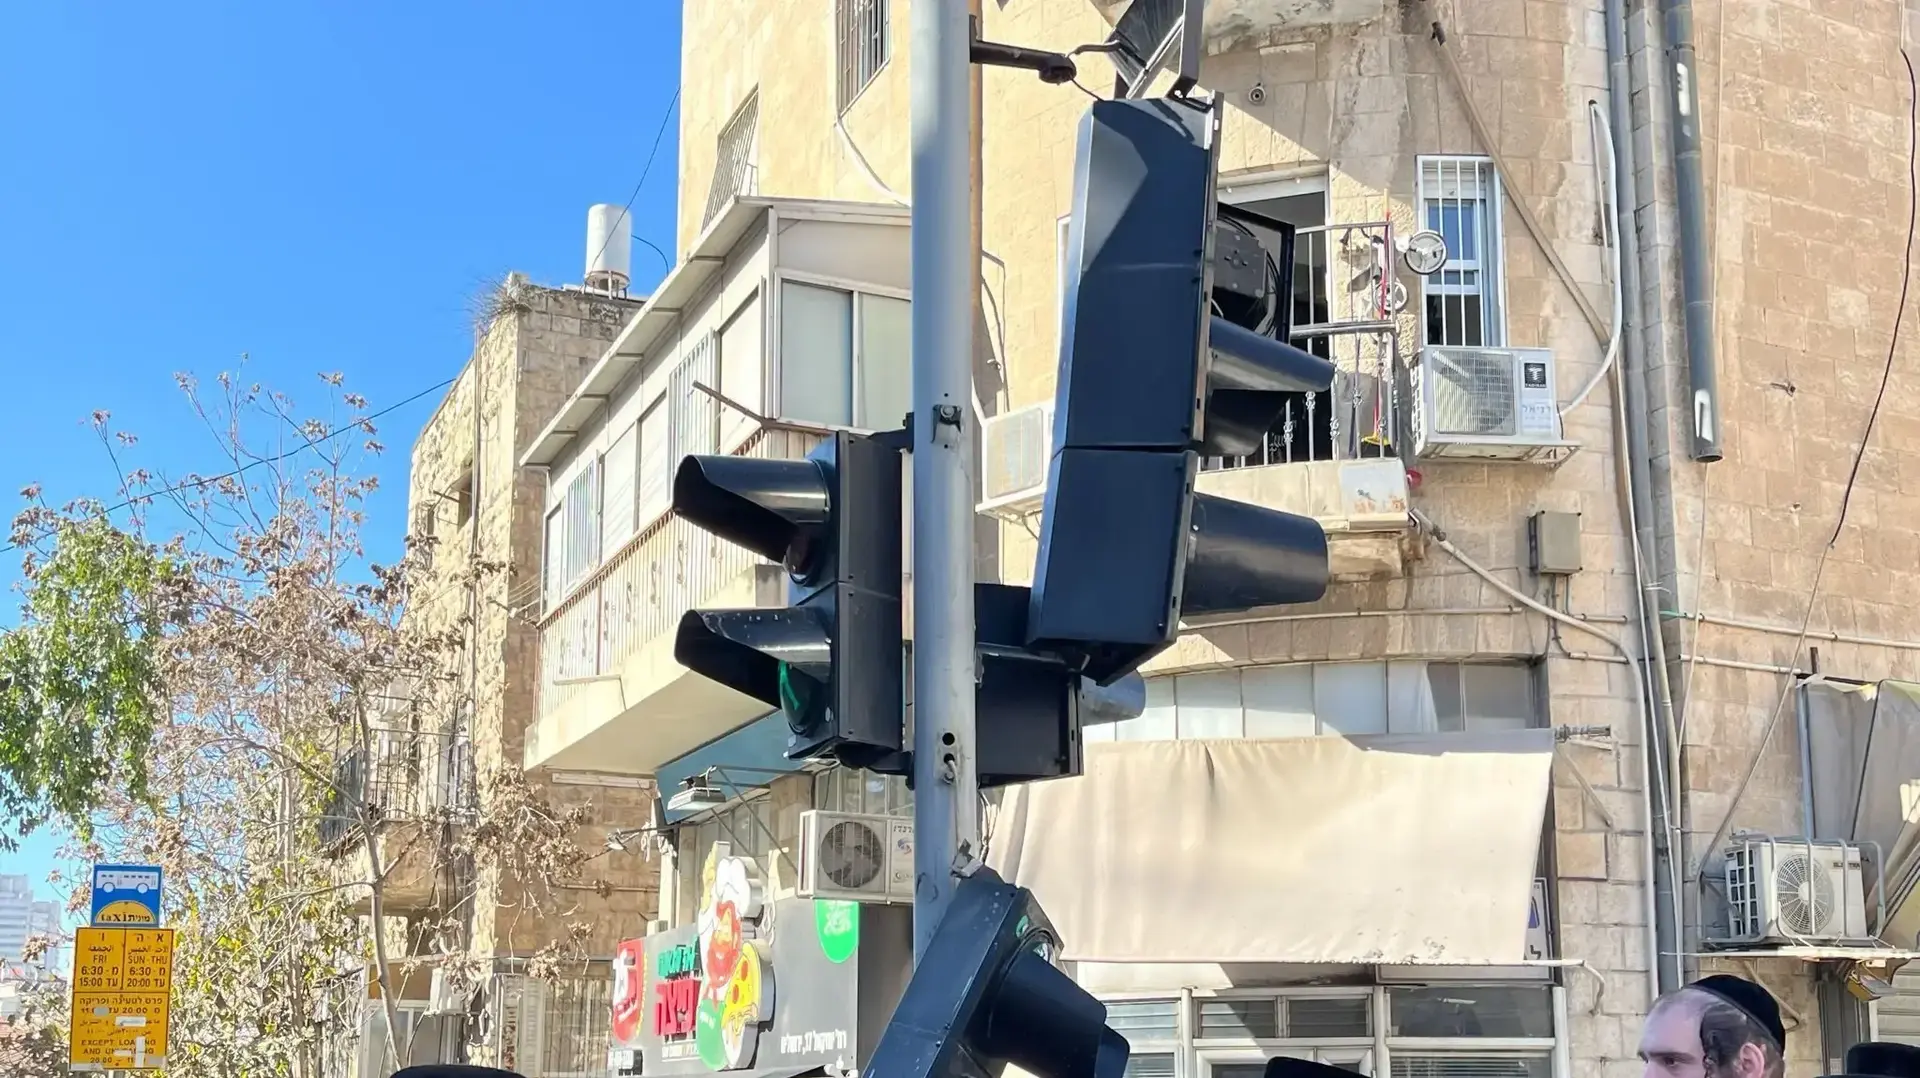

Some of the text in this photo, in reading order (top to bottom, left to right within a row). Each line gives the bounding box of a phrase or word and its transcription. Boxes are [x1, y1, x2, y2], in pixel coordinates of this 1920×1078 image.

[93, 955, 107, 964] FRI
[128, 956, 145, 964] SUN
[151, 956, 168, 964] THU
[81, 965, 104, 975] 6:30
[129, 966, 151, 976] 6:30
[79, 977, 102, 987] 15:00
[127, 978, 150, 987] 20:00
